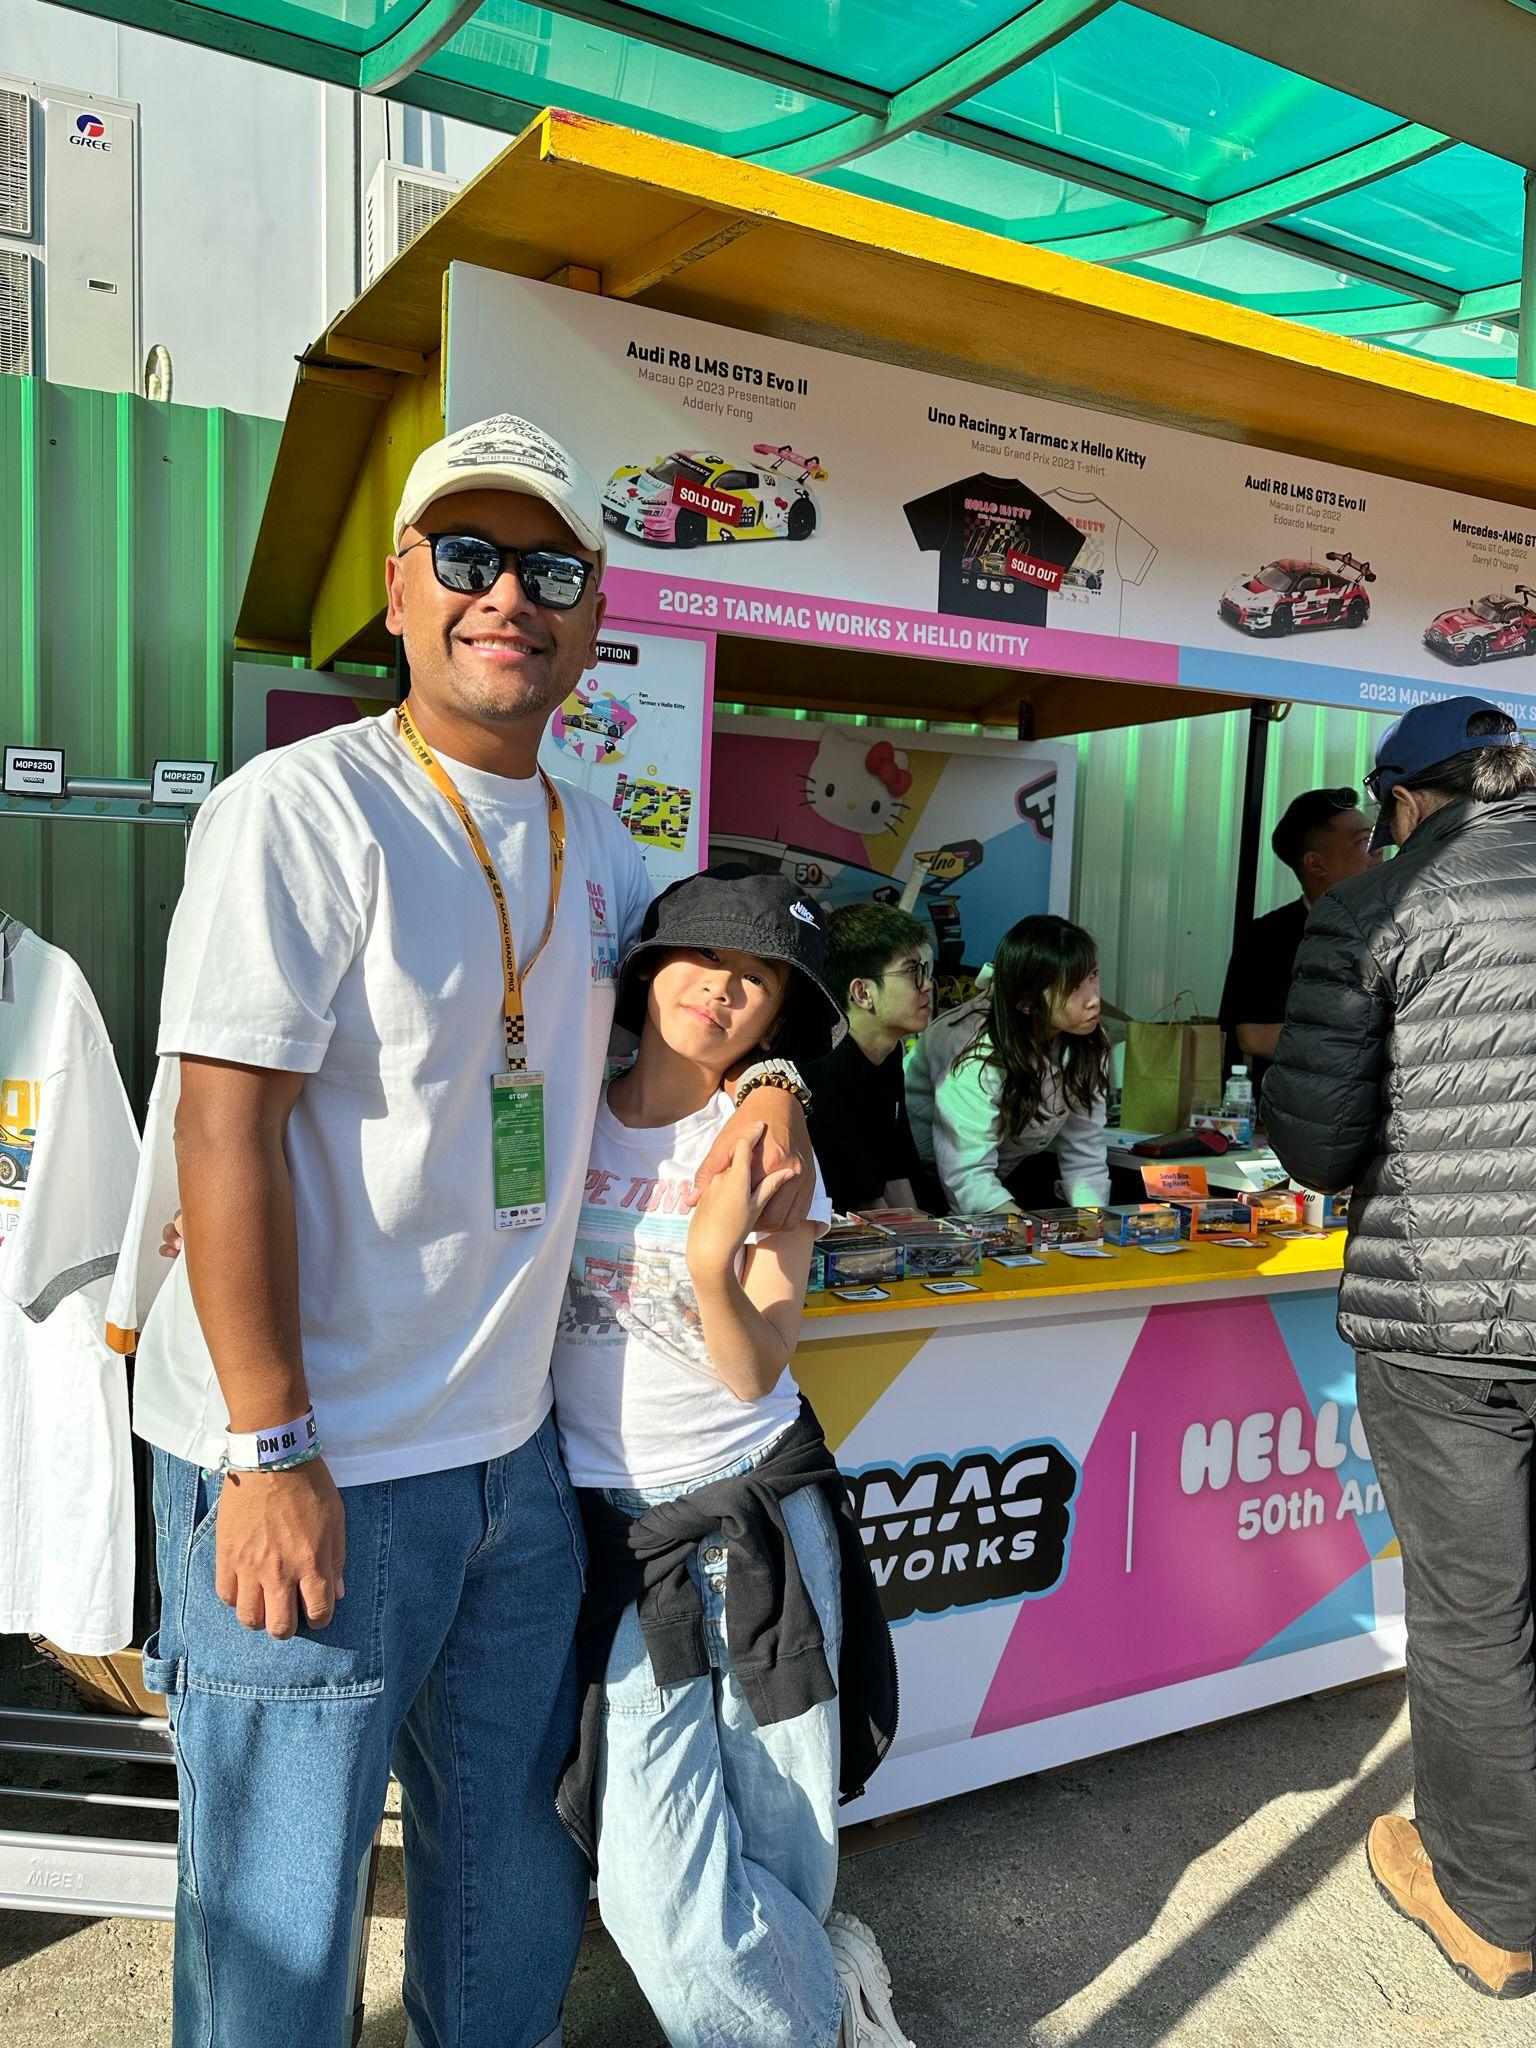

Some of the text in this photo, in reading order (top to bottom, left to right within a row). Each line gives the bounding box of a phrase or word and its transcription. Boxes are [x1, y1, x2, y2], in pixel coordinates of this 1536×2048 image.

[69, 135, 112, 153] GREE
[626, 340, 808, 396] Audi R8 LMS GT3 Evo II
[638, 367, 796, 411] Macau GP 2023 Presentation
[682, 395, 754, 423] Adderly Fong
[927, 405, 1147, 470] Uno Racing x Tarmac x Hello Kitty
[971, 440, 1106, 477] Macau Grand Prix 2023 T-shirt
[679, 487, 710, 509] SOLD
[711, 499, 736, 518] OUT
[1244, 474, 1366, 512] Audi R8 LMS GT3 Evo II
[1269, 498, 1342, 522] Macau GT Cup 2022
[1273, 514, 1335, 535] Edoardo Mortara
[1452, 518, 1523, 545] Mercedes-AMG
[1466, 539, 1487, 552] Macau
[1497, 546, 1510, 557] Cup
[1511, 548, 1528, 560] 2022
[1010, 557, 1059, 584] SOLD OUT
[658, 588, 1030, 657] 2023 TARMAC WORKS X HELLO KITTY
[638, 699, 657, 707] Tarmac
[661, 701, 673, 709] Hello
[673, 703, 686, 711] Kitty
[1359, 682, 1396, 702] 2023
[15, 760, 53, 771] MOP$250
[164, 771, 203, 781] MOP$250
[795, 863, 823, 886] 50
[794, 901, 815, 923] NIKE
[498, 902, 516, 993] MACAU GRAND PRIX
[282, 1432, 298, 1449] 18
[858, 1456, 1050, 1545] MAC
[1237, 1488, 1324, 1540] 50th
[869, 1530, 1038, 1587] WORKS
